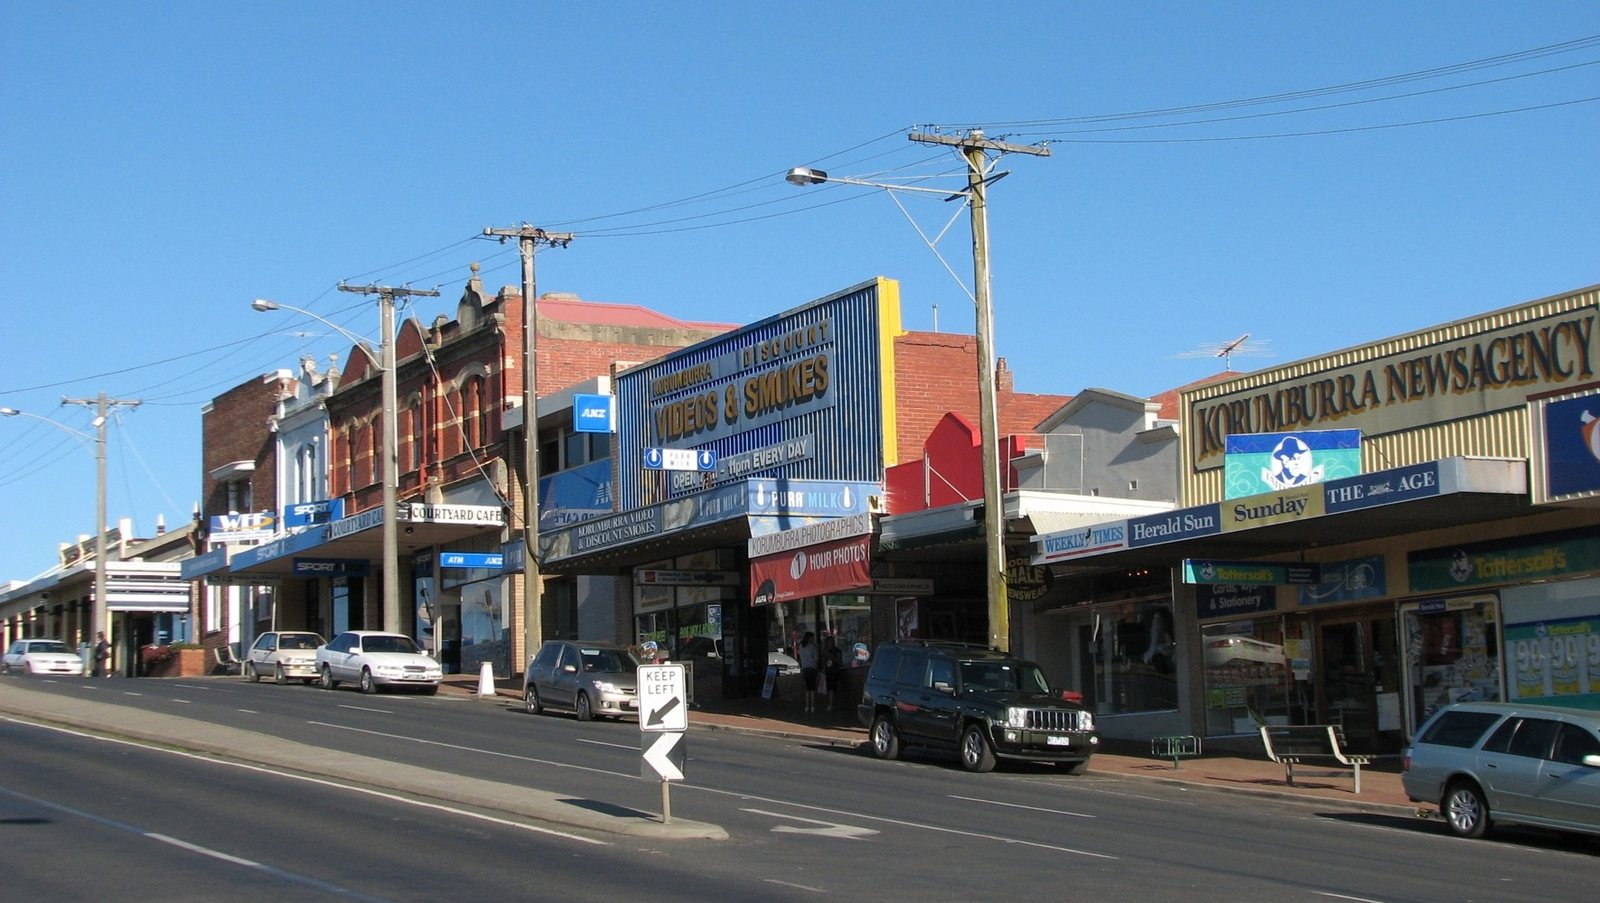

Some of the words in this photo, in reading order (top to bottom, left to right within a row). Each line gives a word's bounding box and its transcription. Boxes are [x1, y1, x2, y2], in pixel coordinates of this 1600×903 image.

[653, 363, 713, 397] KORUMBURRA
[743, 323, 828, 368] DISCOUNT
[655, 391, 718, 441] VIDEOS
[724, 384, 738, 424] &
[744, 354, 829, 422] SMOKES
[1196, 370, 1380, 462] KORUMBURRA
[1384, 316, 1595, 405] NEWSAGENCY
[581, 408, 606, 418] ANZ
[752, 449, 785, 473] EVERY
[787, 438, 808, 460] DAY
[808, 492, 839, 509] MILK
[1327, 484, 1365, 505] THE
[1398, 471, 1435, 493] AGE
[294, 503, 328, 515] SPORT
[412, 507, 473, 520] COURTYARD
[476, 511, 502, 522] CAFE
[1234, 496, 1309, 522] Sunday
[334, 514, 372, 536] COURTYARD
[578, 515, 628, 539] KORUMBURRA
[631, 508, 655, 526] VIDEO
[578, 540, 585, 550] &
[586, 528, 623, 548] DISCOUNT
[624, 520, 657, 539] SMOKES
[752, 530, 799, 555] KORUMBURRA
[802, 515, 864, 543] PHOTOGRAPHICS
[1134, 521, 1181, 541] Herald
[1184, 514, 1214, 533] Sun
[1045, 533, 1084, 553] WEEKLY
[1093, 526, 1124, 544] TIMES
[297, 562, 336, 571] SPORT
[447, 556, 464, 564] ATM
[810, 549, 832, 570] HOUR
[833, 544, 865, 566] PHOTOS
[1475, 547, 1567, 579] Tattersall's
[1006, 565, 1045, 584] MALE
[1007, 586, 1047, 601] ENSWEAR
[1219, 595, 1262, 609] Stationery
[646, 671, 676, 682] KEEP
[648, 685, 675, 695] LEFT
